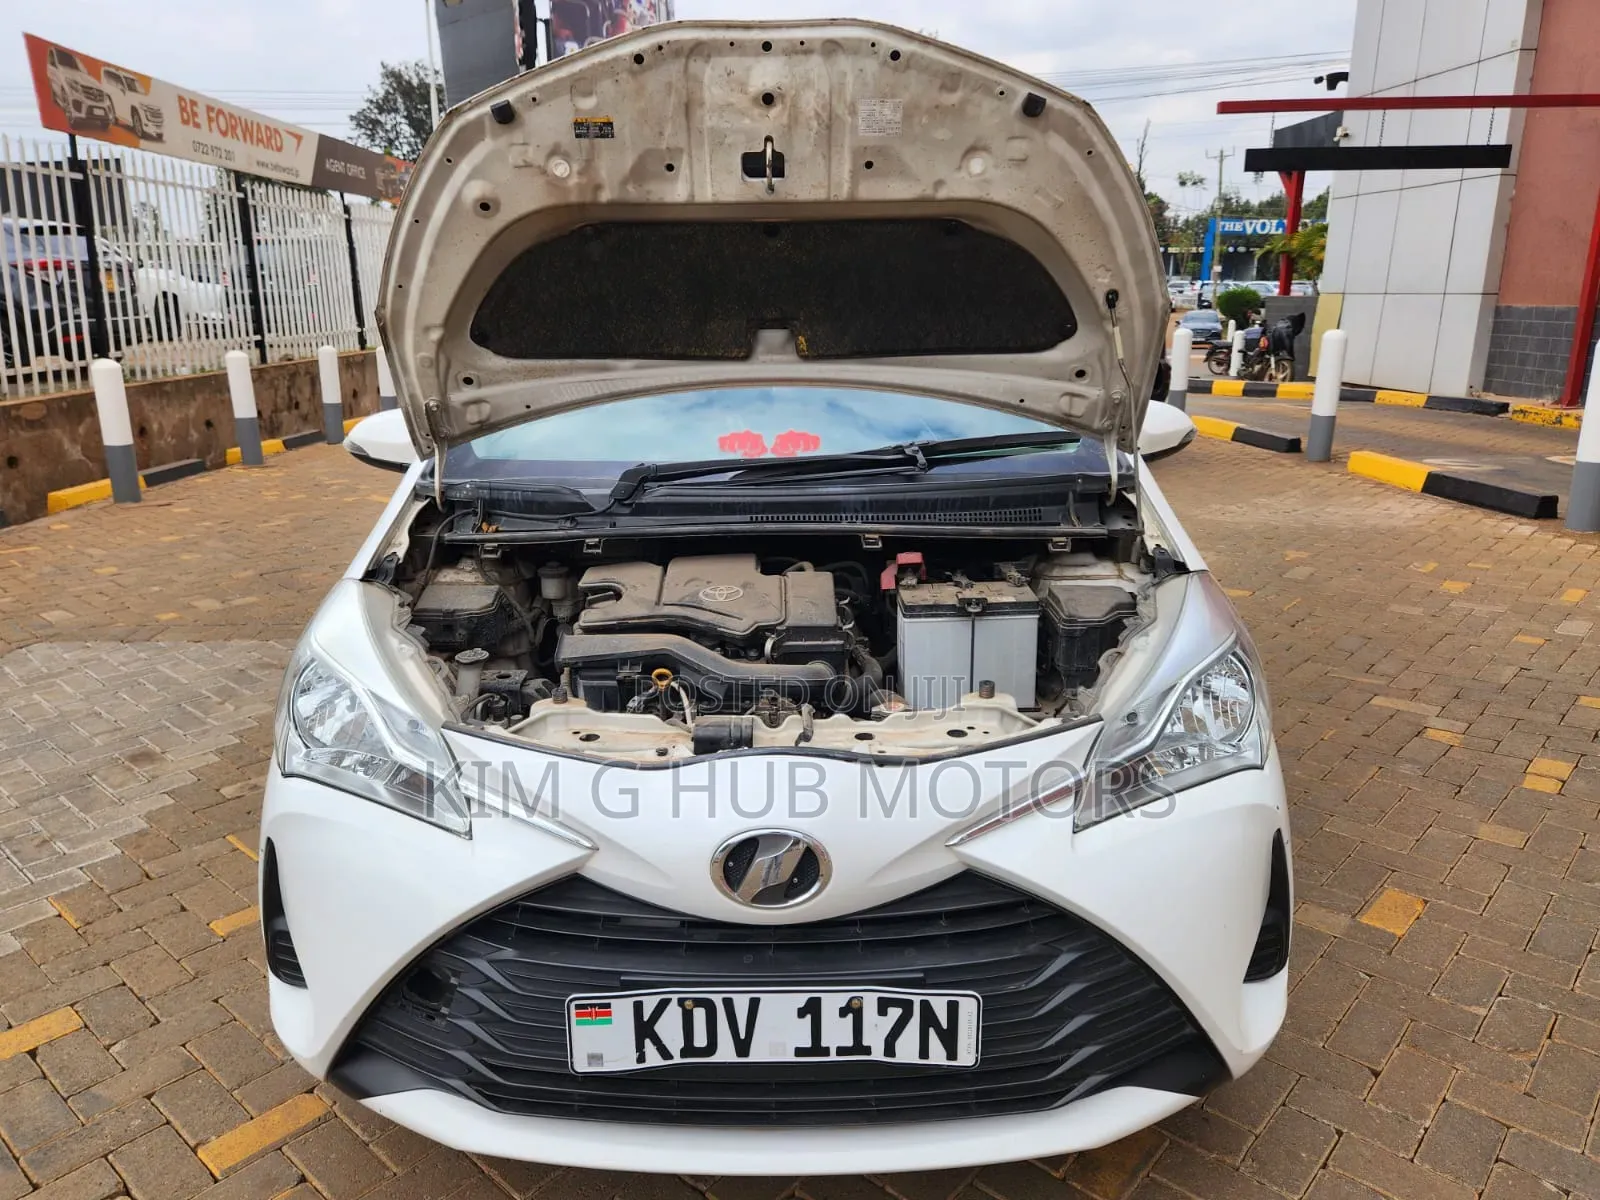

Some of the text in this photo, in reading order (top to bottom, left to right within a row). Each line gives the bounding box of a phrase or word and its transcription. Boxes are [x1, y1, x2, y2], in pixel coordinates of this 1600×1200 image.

[177, 95, 284, 153] BE FORWARD
[326, 158, 367, 181] AGENT OFFICE
[1217, 221, 1243, 232] THE
[632, 997, 762, 1065] KDV
[793, 996, 960, 1062] 117N
